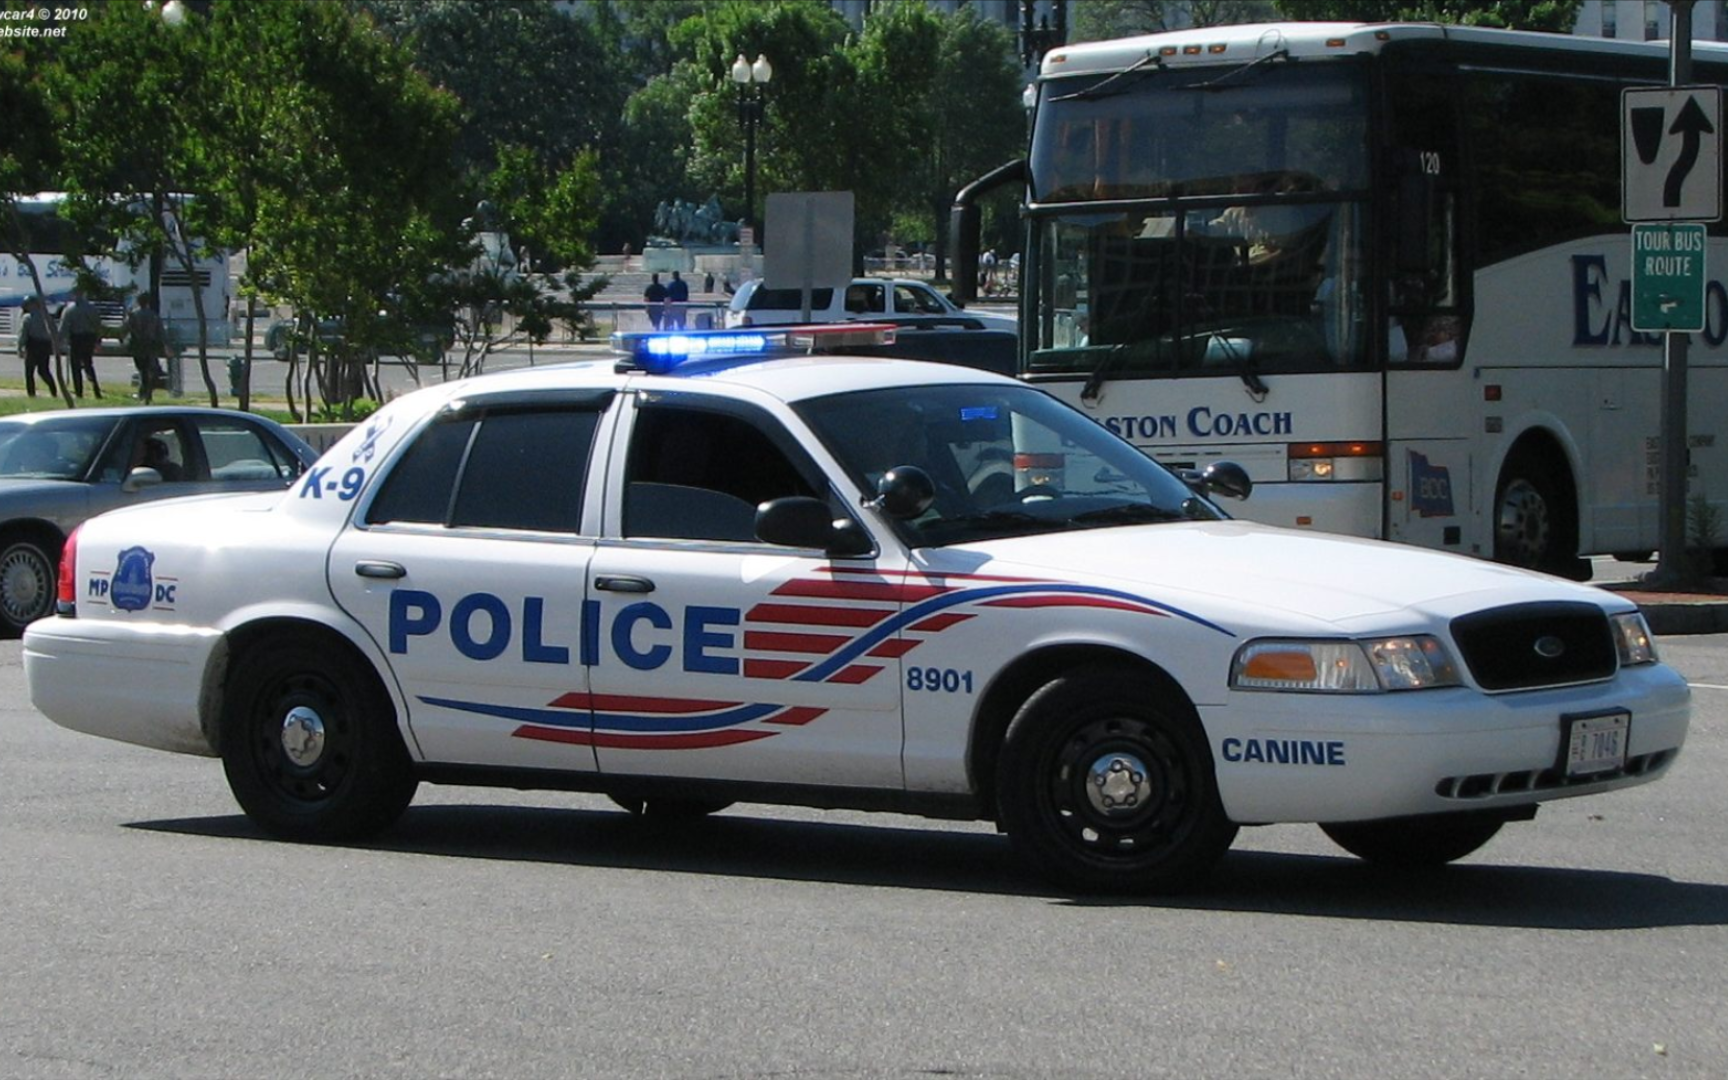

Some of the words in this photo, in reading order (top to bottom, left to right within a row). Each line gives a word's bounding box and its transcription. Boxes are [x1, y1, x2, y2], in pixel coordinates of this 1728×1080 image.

[1420, 151, 1440, 174] 120
[1636, 231, 1671, 251] TOUR
[1674, 231, 1701, 251] BUS
[1645, 257, 1692, 276] ROUTE
[1095, 415, 1177, 439] STON
[299, 466, 366, 501] K-9
[89, 579, 109, 597] MP
[155, 584, 176, 603] DC
[389, 589, 741, 675] POLICE
[907, 666, 973, 694] 8901
[1222, 738, 1346, 765] CANINE
